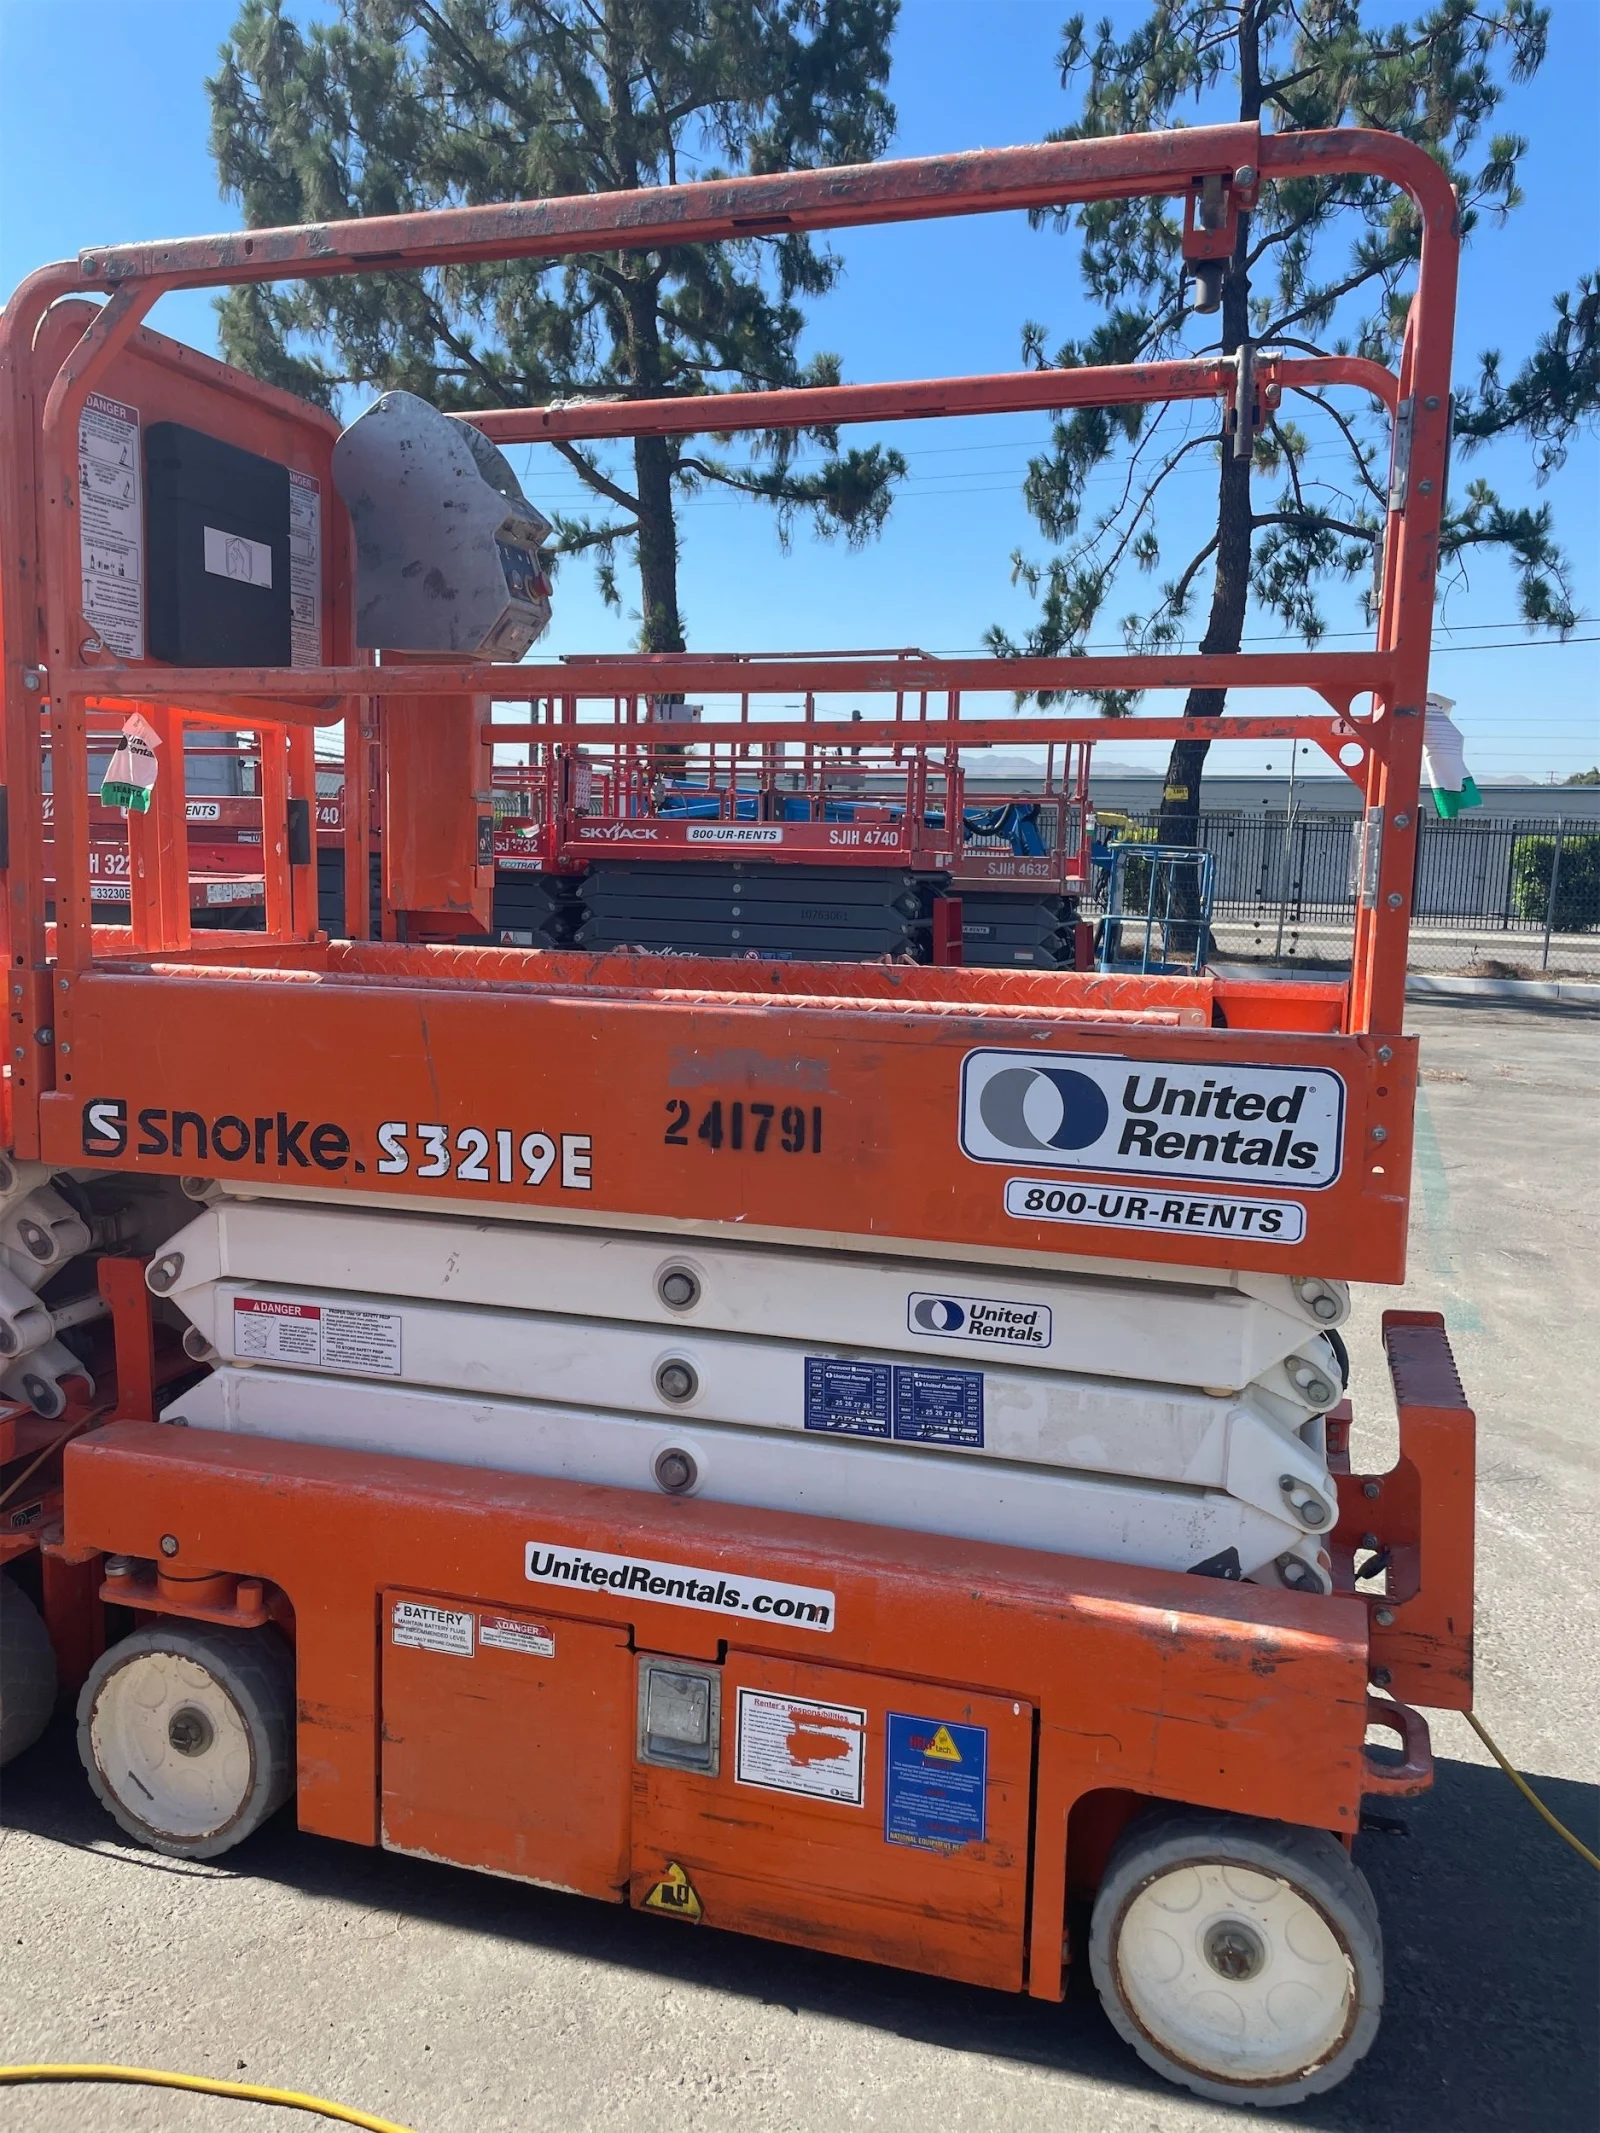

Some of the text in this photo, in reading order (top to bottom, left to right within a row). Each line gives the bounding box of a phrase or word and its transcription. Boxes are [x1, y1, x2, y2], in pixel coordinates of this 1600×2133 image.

[86, 395, 127, 419] DANGER
[186, 805, 217, 816] ENTS
[580, 823, 658, 840] SKYJACK
[692, 828, 777, 841] 800-UR-RENTS
[864, 830, 899, 846] 4740
[1019, 862, 1049, 876] 4632
[1122, 1075, 1307, 1124] United
[664, 1099, 822, 1153] 241791
[1117, 1118, 1319, 1170] Rentals
[377, 1121, 592, 1190] S3219E
[1024, 1188, 1283, 1234] 800-UR-RENTS
[261, 1302, 301, 1316] DANGER
[969, 1304, 1037, 1325] United
[968, 1320, 1043, 1342] Rentals
[531, 1551, 830, 1625] UnitedRentals.com
[404, 1606, 463, 1625] BATTERY
[503, 1621, 538, 1636] DANGER
[755, 1698, 785, 1710] Renter's
[936, 1745, 951, 1755] tech
